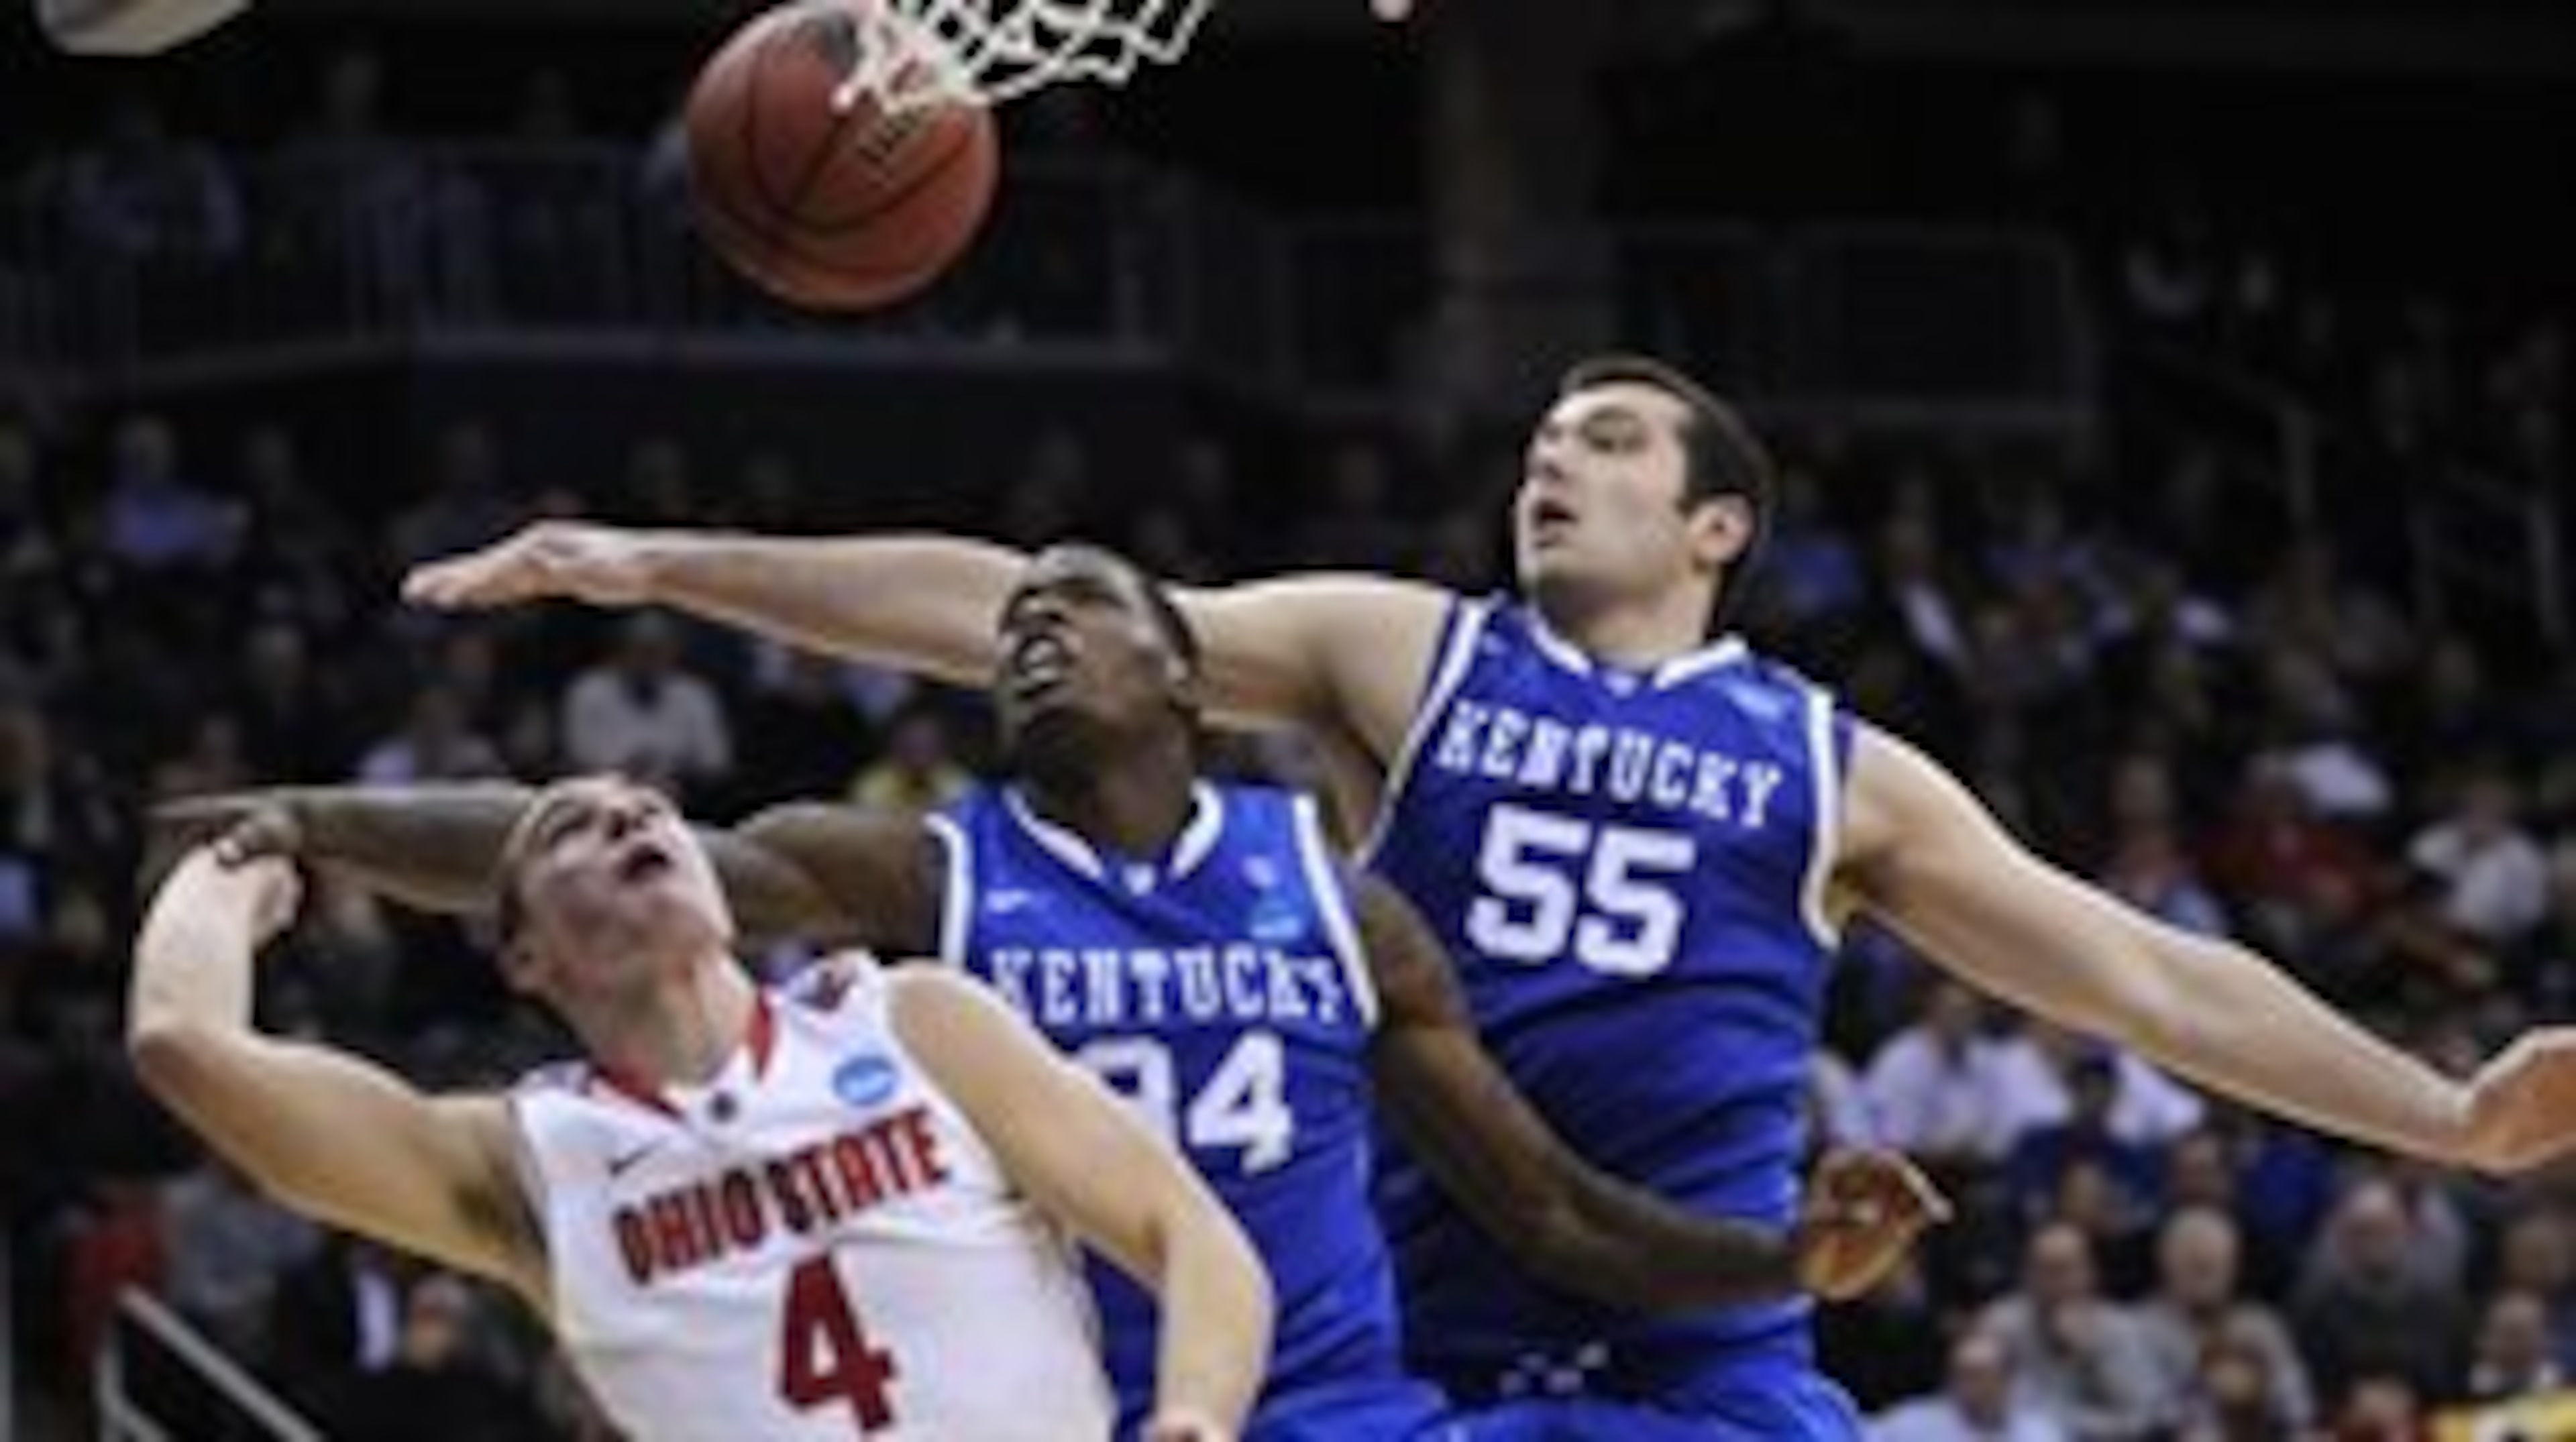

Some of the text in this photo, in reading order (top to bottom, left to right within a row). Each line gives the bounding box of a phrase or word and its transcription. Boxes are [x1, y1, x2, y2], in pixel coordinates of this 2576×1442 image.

[1436, 700, 1782, 827] KENTUCKY
[1466, 803, 1696, 976] 55
[991, 946, 1342, 1024] KENTUCKY
[613, 1107, 949, 1284] OHIO STATE
[780, 1253, 896, 1433] 4
